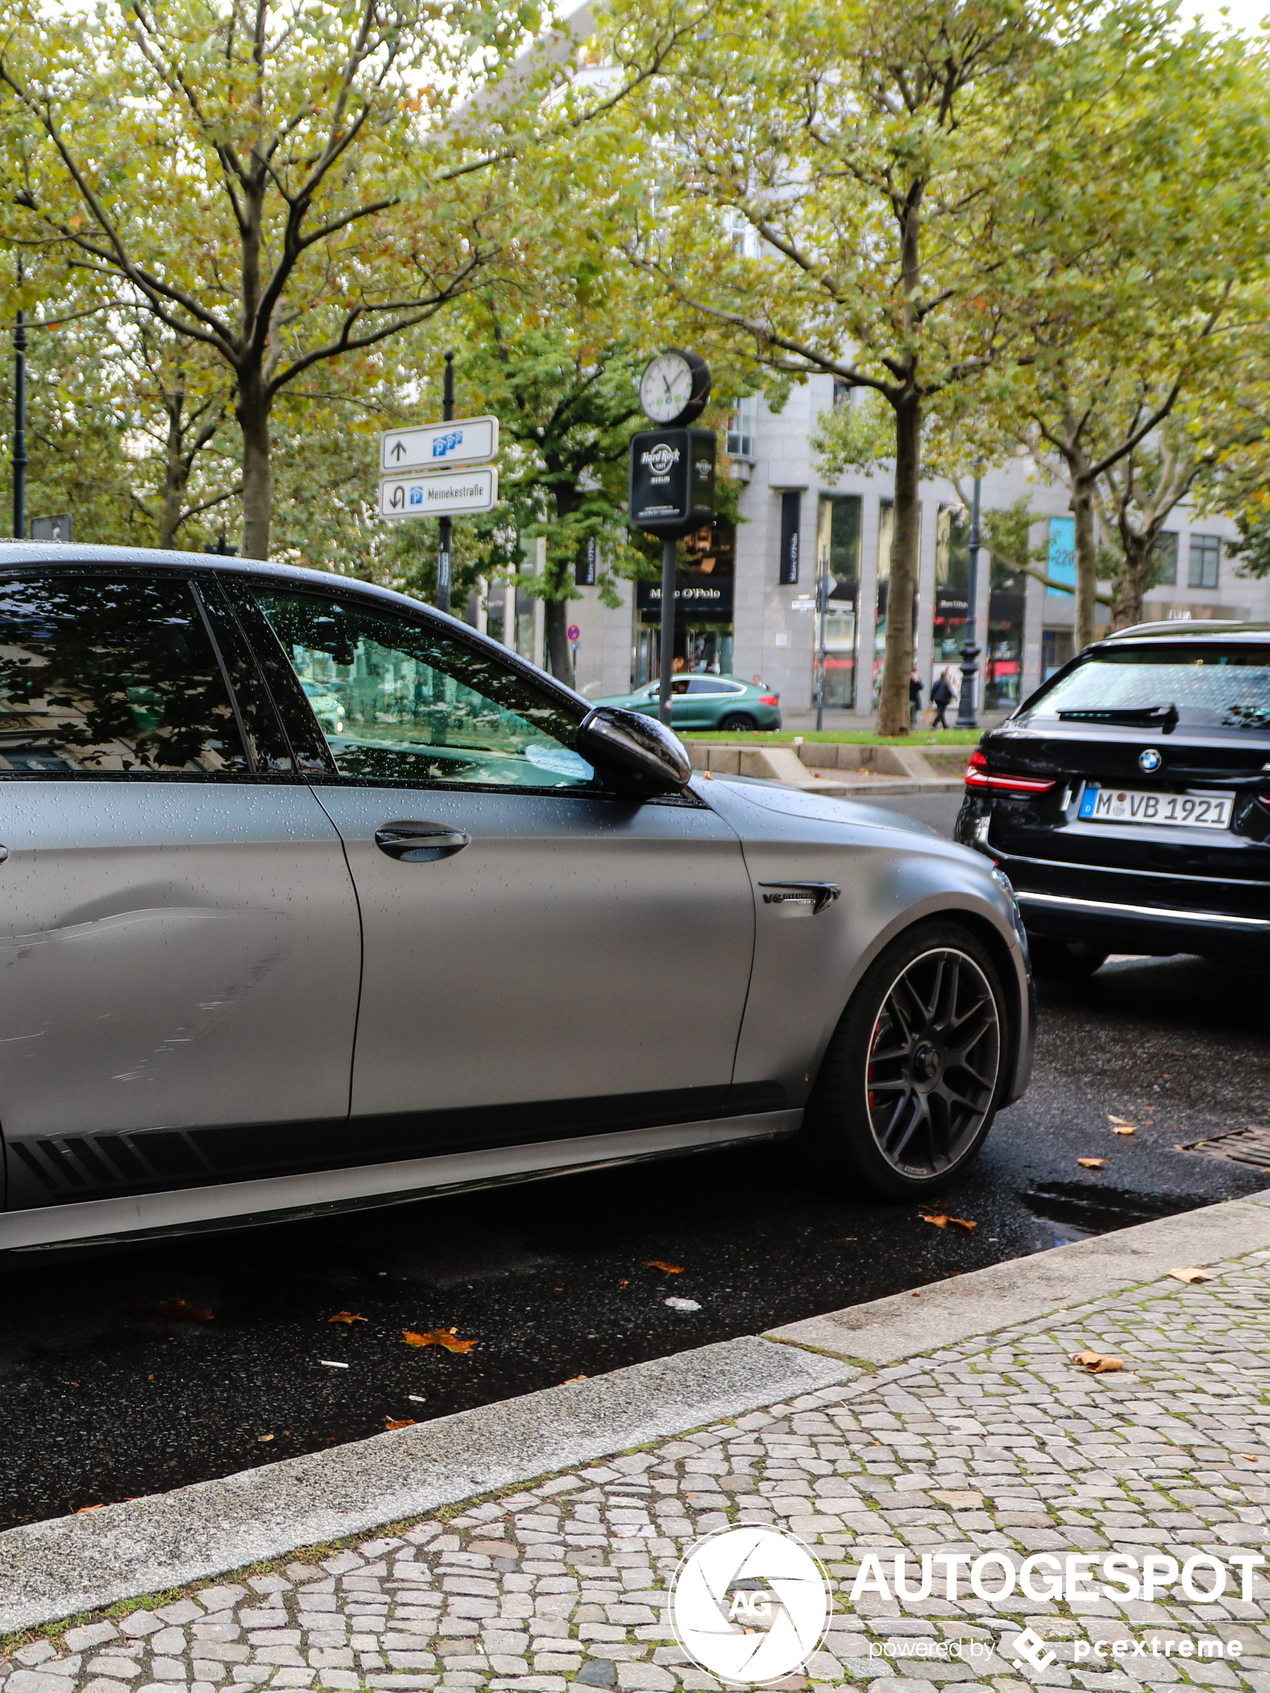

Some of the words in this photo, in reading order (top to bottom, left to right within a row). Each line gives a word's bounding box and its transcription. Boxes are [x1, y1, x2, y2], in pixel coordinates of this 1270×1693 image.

[428, 483, 484, 500] Meinekestraße
[650, 588, 680, 599] Mc
[681, 587, 721, 599] O'Polo
[1096, 792, 1113, 815] M
[1130, 794, 1160, 818] VB
[1164, 798, 1227, 824] 1921
